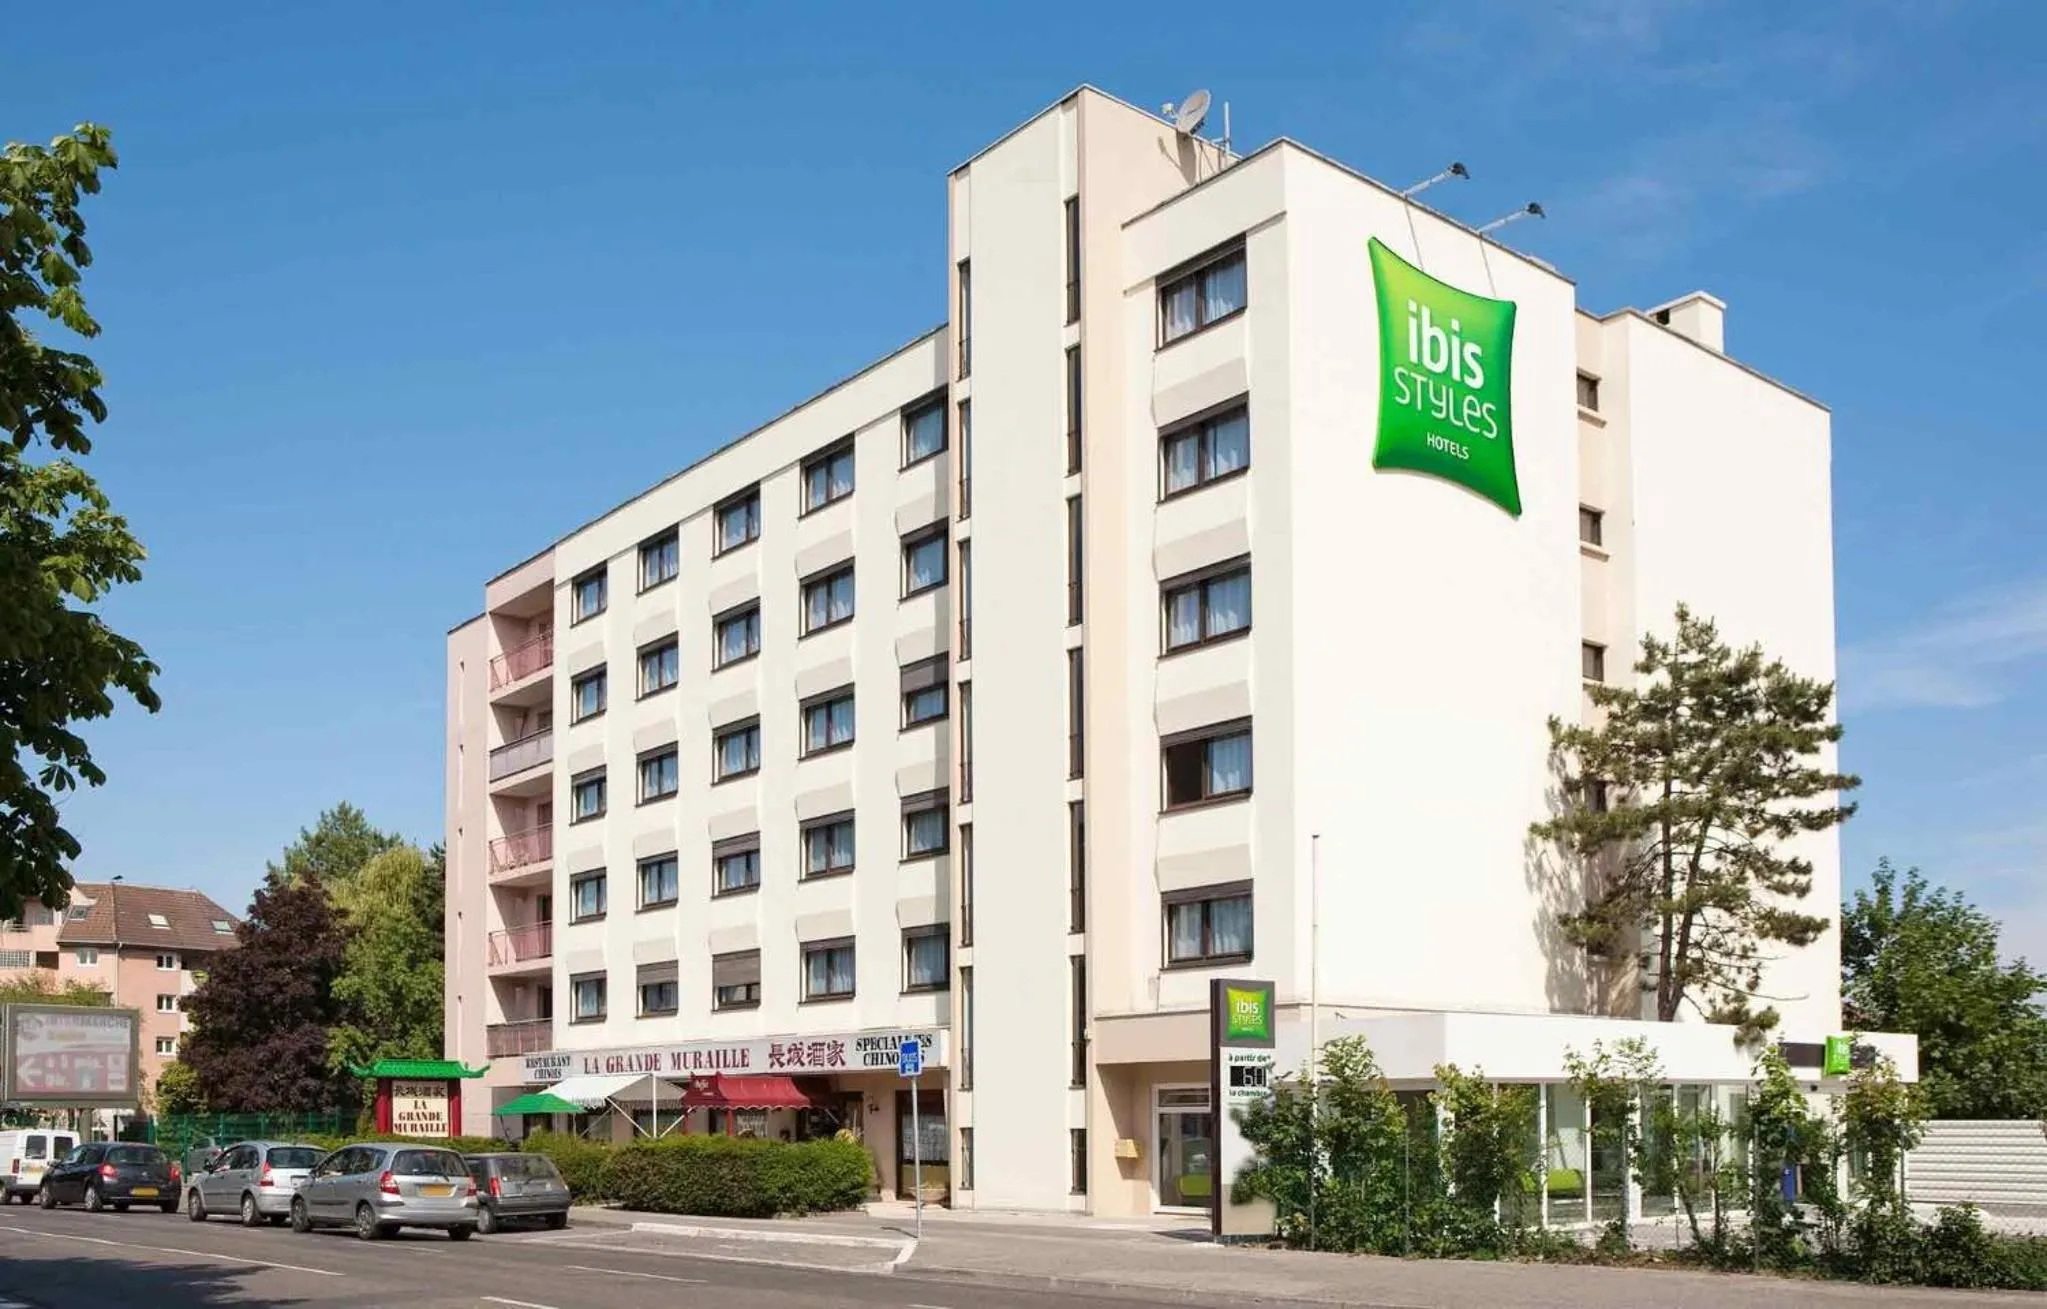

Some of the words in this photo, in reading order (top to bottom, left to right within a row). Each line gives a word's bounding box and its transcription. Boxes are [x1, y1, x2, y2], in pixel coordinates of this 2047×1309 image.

[1407, 298, 1485, 389] ibis
[1426, 432, 1470, 460] HOTELS
[1236, 998, 1259, 1014] ibis
[583, 1057, 600, 1074] LA
[606, 1053, 662, 1073] GRANDE
[671, 1048, 750, 1070] MURAILLE
[1243, 1066, 1265, 1087] 60
[414, 1099, 427, 1110] LA
[398, 1111, 443, 1121] GRANDE
